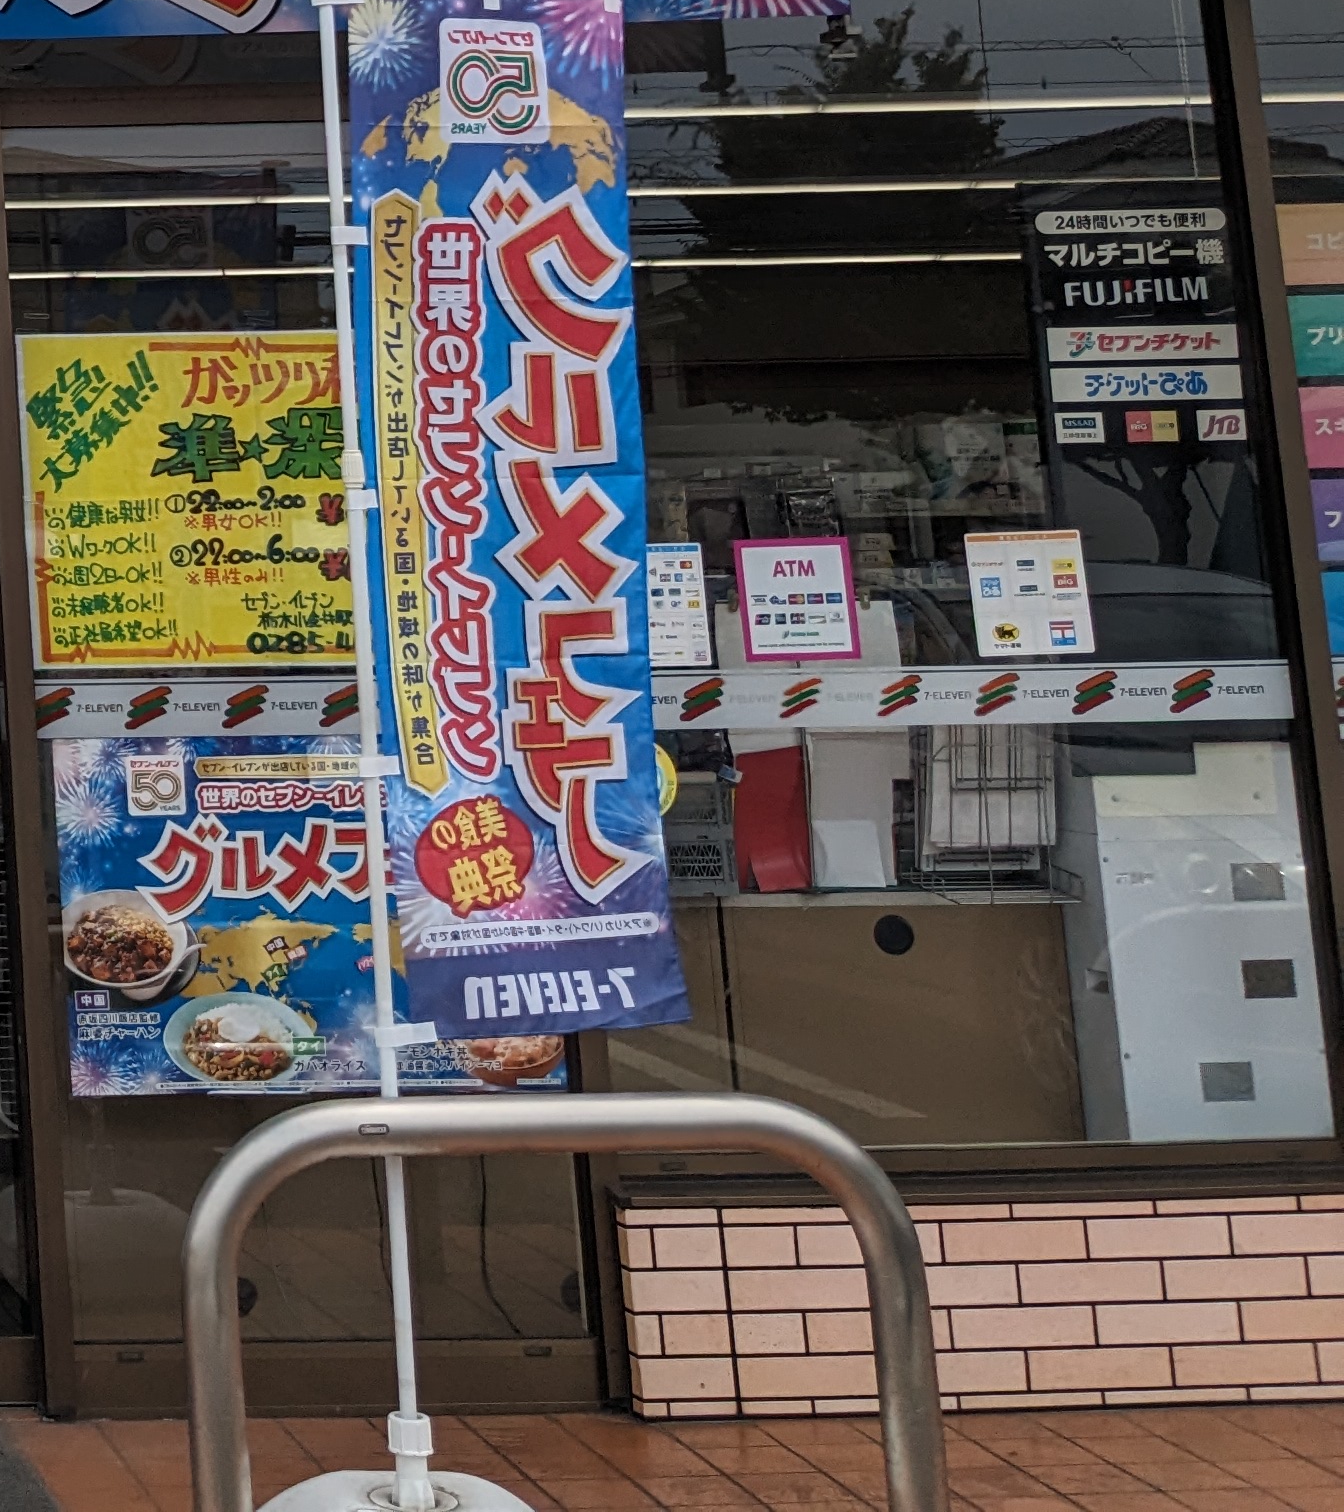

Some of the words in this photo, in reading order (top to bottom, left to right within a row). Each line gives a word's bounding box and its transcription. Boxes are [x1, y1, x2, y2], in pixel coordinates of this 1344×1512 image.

[1055, 211, 1206, 231] 24時間いつでも便利
[1043, 238, 1225, 268] マルチコピー機
[1097, 331, 1221, 353] セブンチケット
[1084, 370, 1208, 398] チケットぴあ
[25, 357, 113, 441] 緊急
[1202, 414, 1241, 439] JTB
[772, 559, 816, 578] ATM
[130, 769, 182, 812] 50
[80, 993, 106, 1007] 中国
[296, 1040, 323, 1053] タイ
